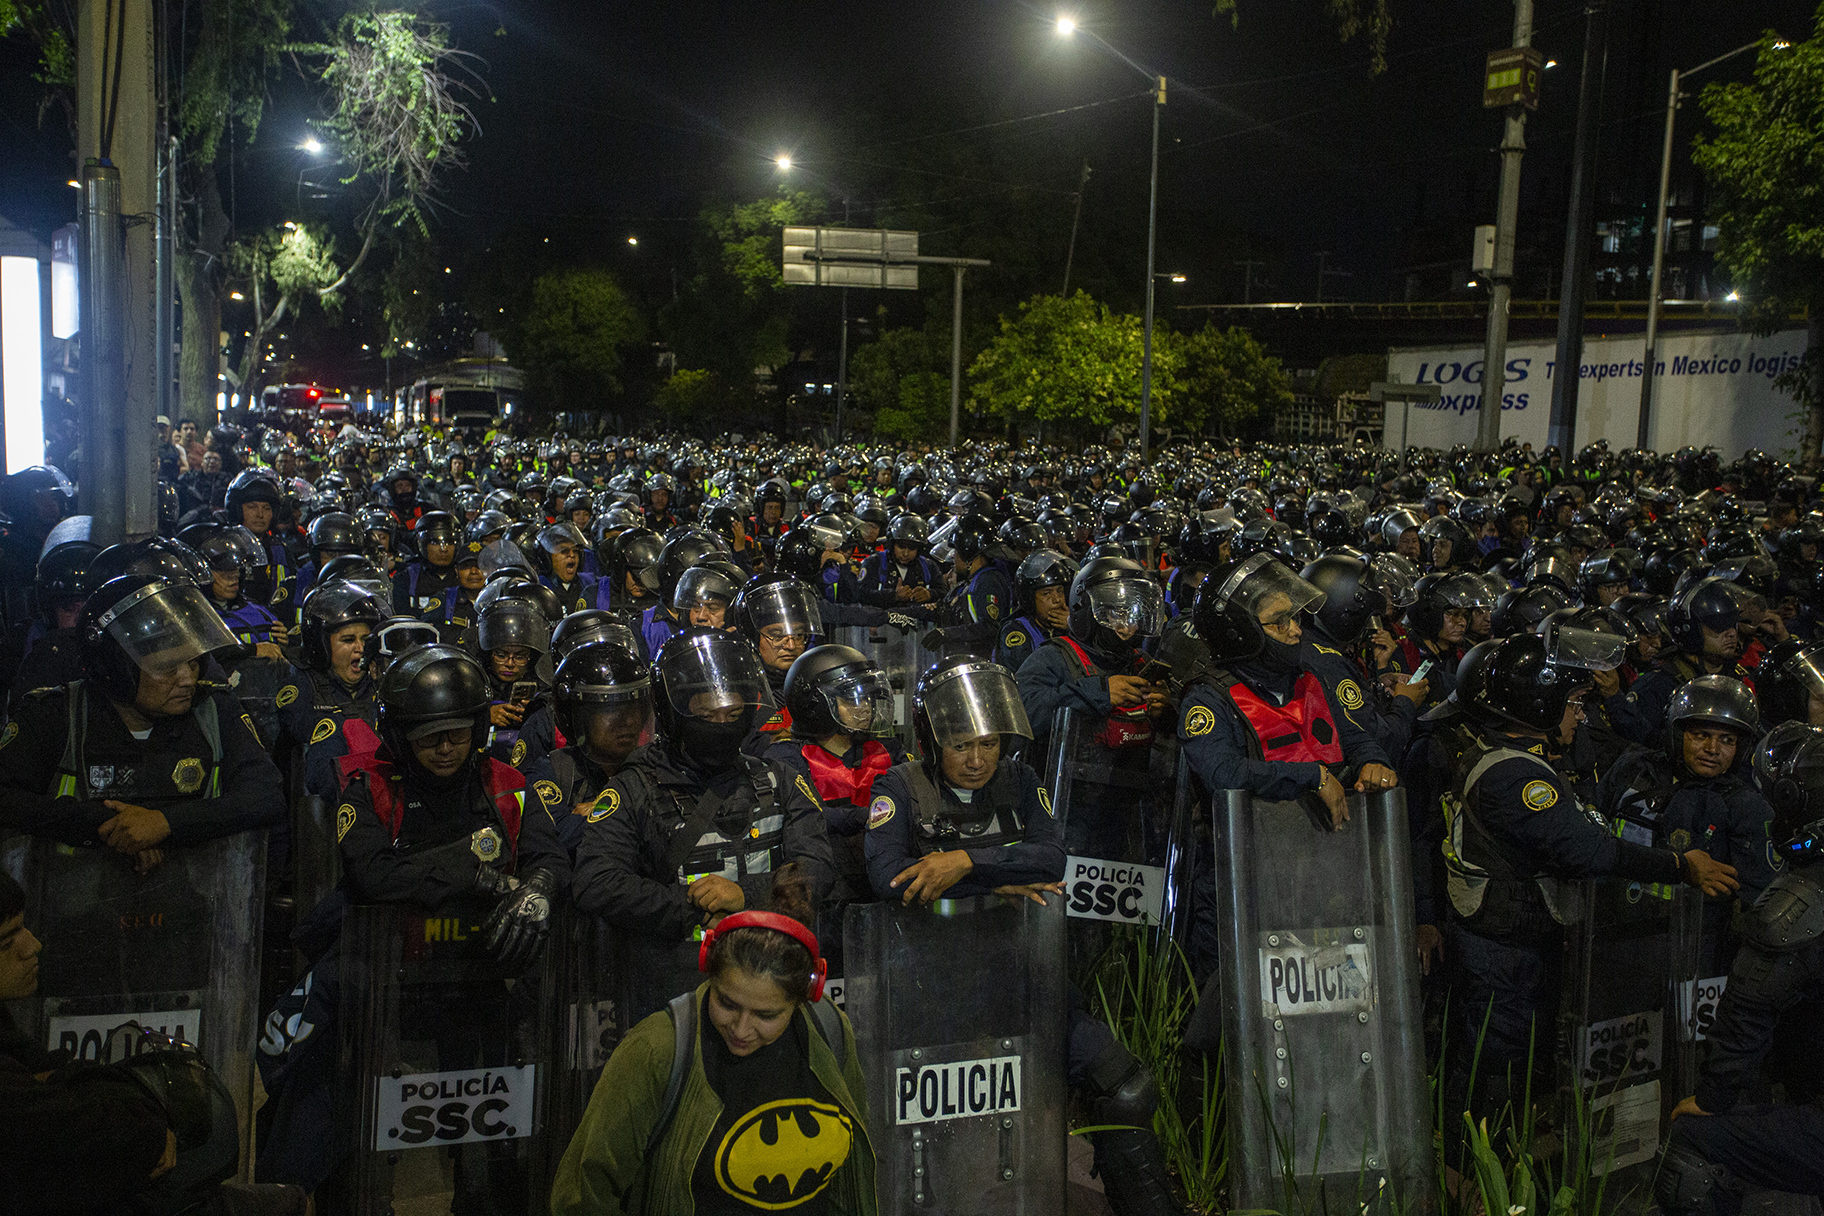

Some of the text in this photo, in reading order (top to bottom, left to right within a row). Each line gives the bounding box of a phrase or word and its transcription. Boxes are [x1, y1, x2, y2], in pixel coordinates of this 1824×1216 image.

[1416, 359, 1531, 384] LOGS
[1580, 360, 1644, 382] experts
[1671, 354, 1741, 376] Mexico
[1075, 864, 1145, 886] POLICÍA
[1069, 881, 1143, 918] SSC
[1590, 1016, 1649, 1046] POLICÍA
[401, 1072, 510, 1102] POLICÍA
[900, 1062, 1017, 1120] POLICIA
[399, 1098, 510, 1143] SSC
